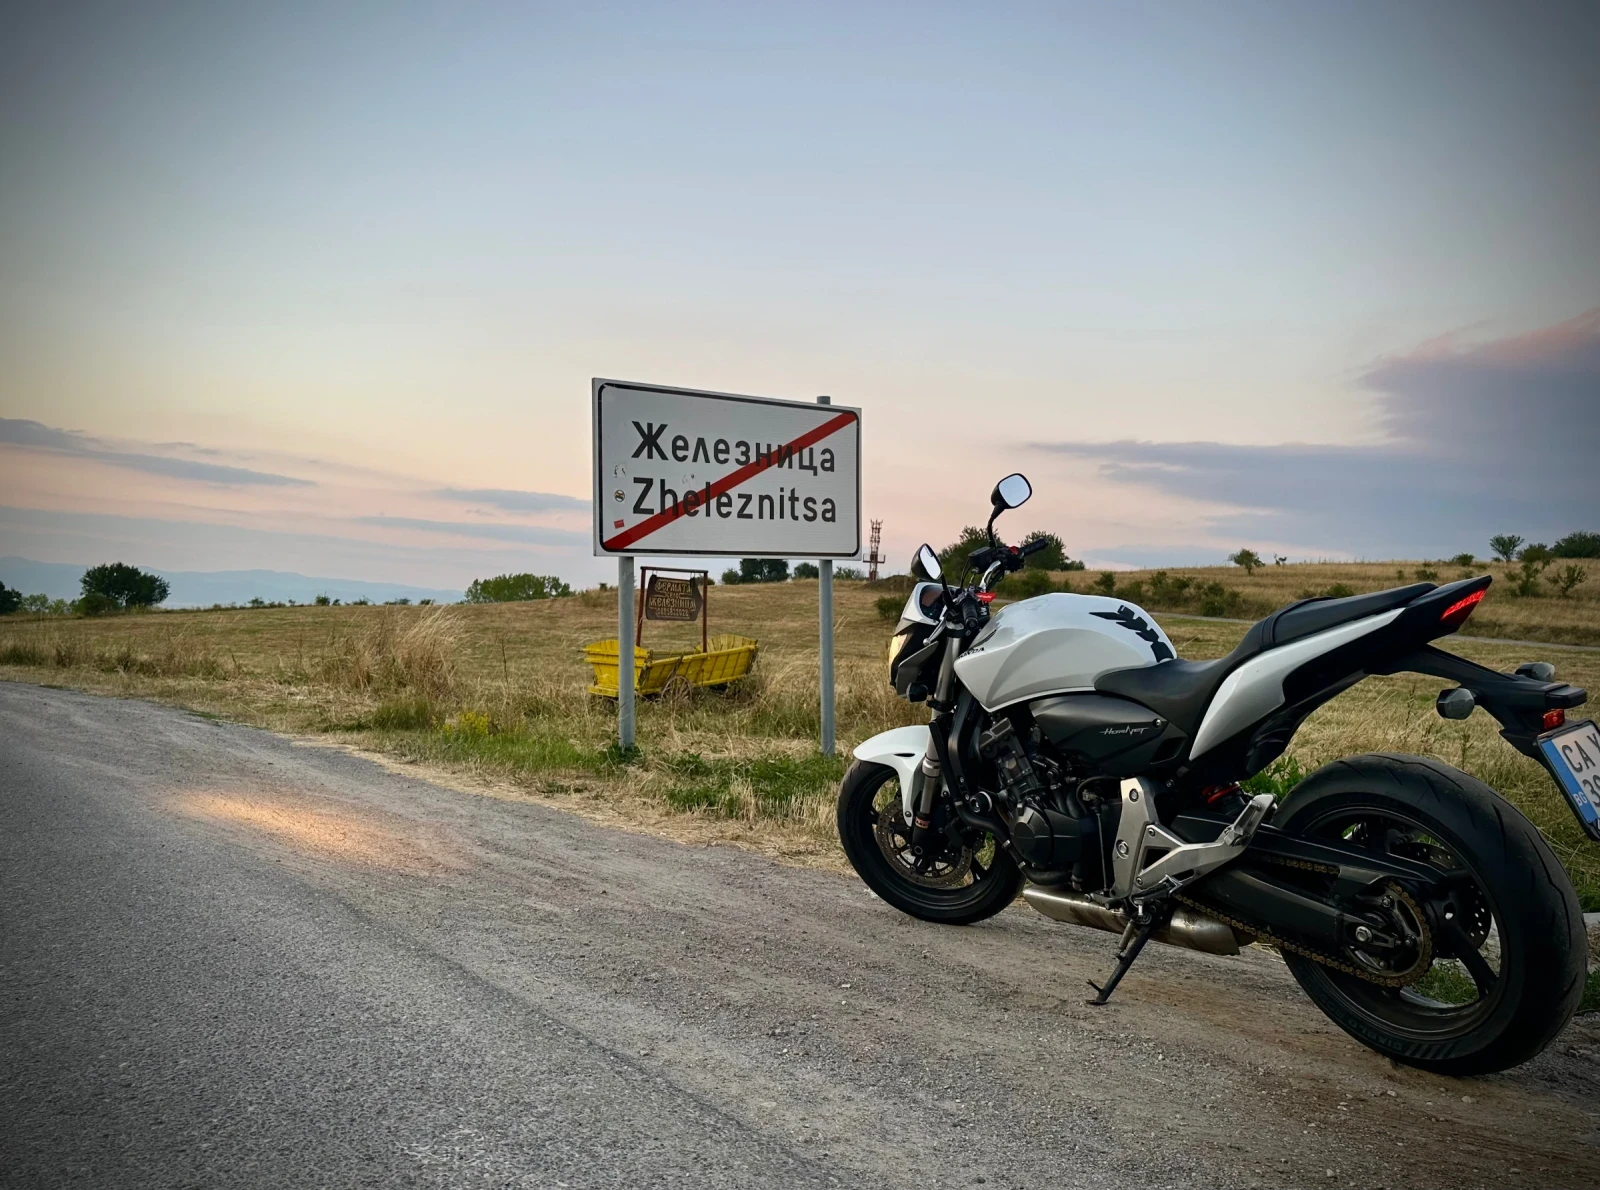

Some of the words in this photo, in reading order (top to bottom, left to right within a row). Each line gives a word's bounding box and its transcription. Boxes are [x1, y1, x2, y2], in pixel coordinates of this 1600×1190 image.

[631, 420, 835, 476] Железница
[632, 477, 836, 522] Zheleznitsa
[1572, 791, 1588, 807] BG
